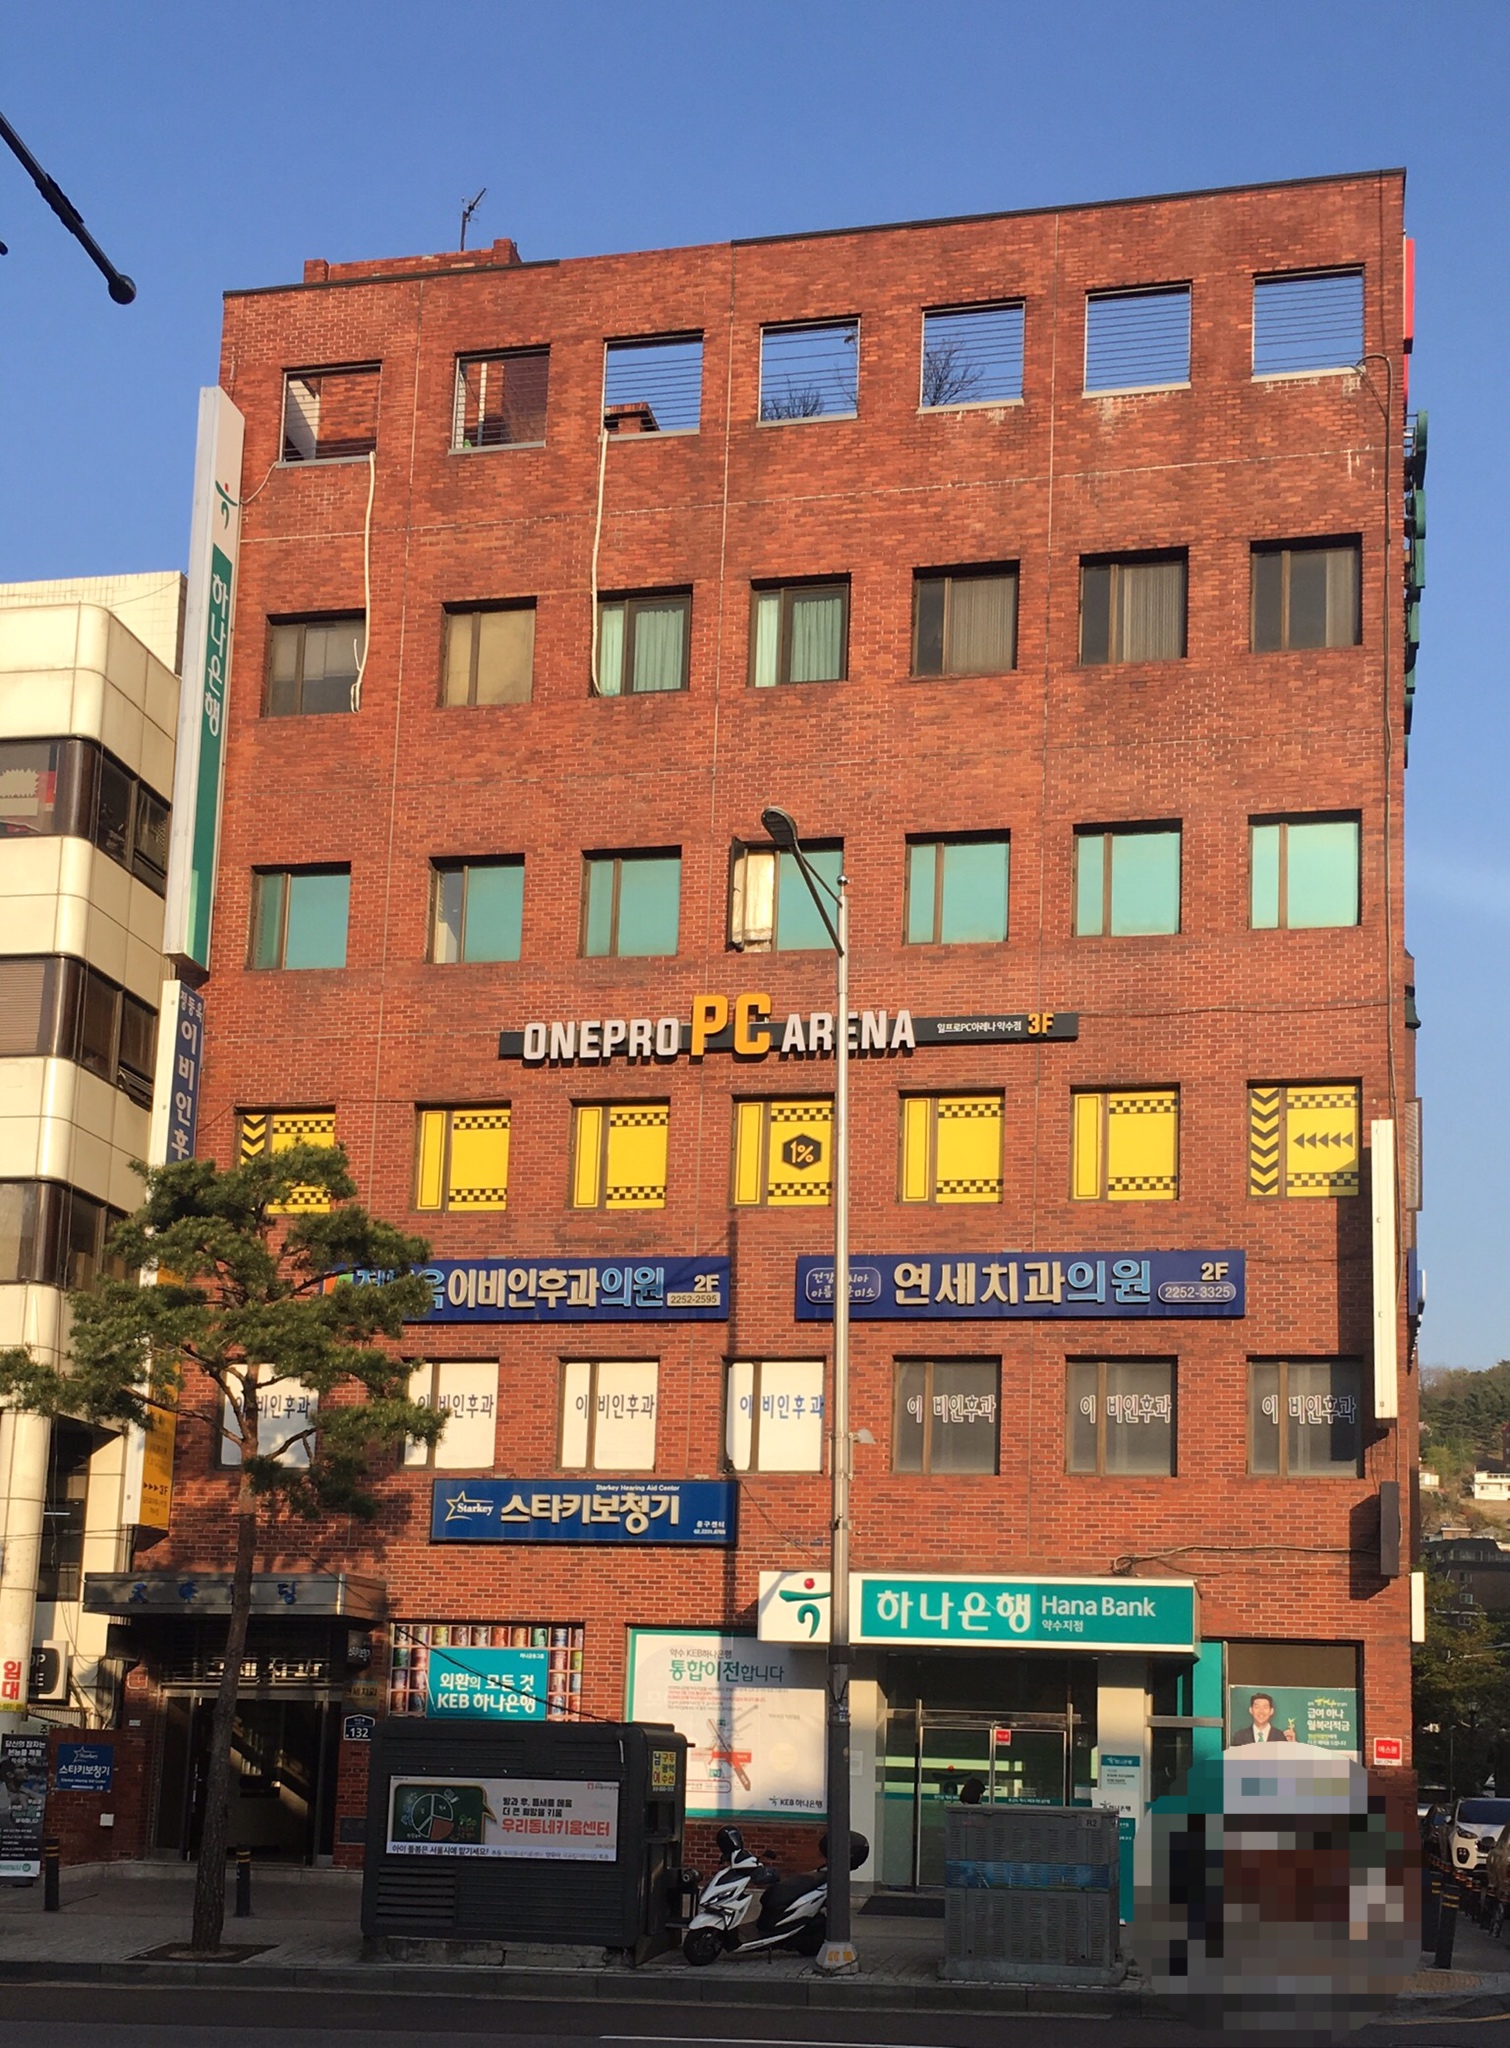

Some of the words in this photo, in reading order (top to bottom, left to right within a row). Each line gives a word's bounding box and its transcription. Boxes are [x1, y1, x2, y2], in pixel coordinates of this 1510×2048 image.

[203, 566, 229, 738] 하나은행
[522, 1017, 680, 1061] ONEPRO
[690, 993, 772, 1056] PC
[781, 1010, 916, 1053] ARENA
[1028, 1012, 1054, 1034] 3F
[1200, 1262, 1229, 1281] 2F
[693, 1274, 719, 1293] 2F
[893, 1259, 1151, 1306] 연세치과의원
[1165, 1284, 1231, 1299] 2252-3325
[670, 1294, 718, 1305] 2252-2595
[596, 1484, 619, 1492] Starkey
[620, 1484, 645, 1492] Hearing
[456, 1502, 493, 1516] Starkey
[501, 1494, 680, 1535] 스타키보청기
[877, 1590, 1032, 1634] 하나은행
[1042, 1595, 1097, 1616] Hana
[1101, 1597, 1156, 1618] Bank
[1042, 1620, 1084, 1633] 약수지점
[669, 1648, 685, 1659] 약수
[2, 1661, 21, 1700] 임대
[669, 1659, 784, 1683] 통합이전합니다
[440, 1673, 481, 1691] 외환의
[485, 1674, 515, 1692] 모든
[520, 1674, 534, 1693] 것
[437, 1693, 470, 1709] KEB
[473, 1693, 536, 1714] 하나은행
[1307, 1708, 1324, 1719] 급여
[350, 1727, 369, 1738] 132
[59, 1764, 110, 1779] 스타키보청기
[795, 1799, 823, 1808] 하나은행
[502, 1818, 610, 1837] 우리동네키움센터
[1086, 1819, 1098, 1828] R2
